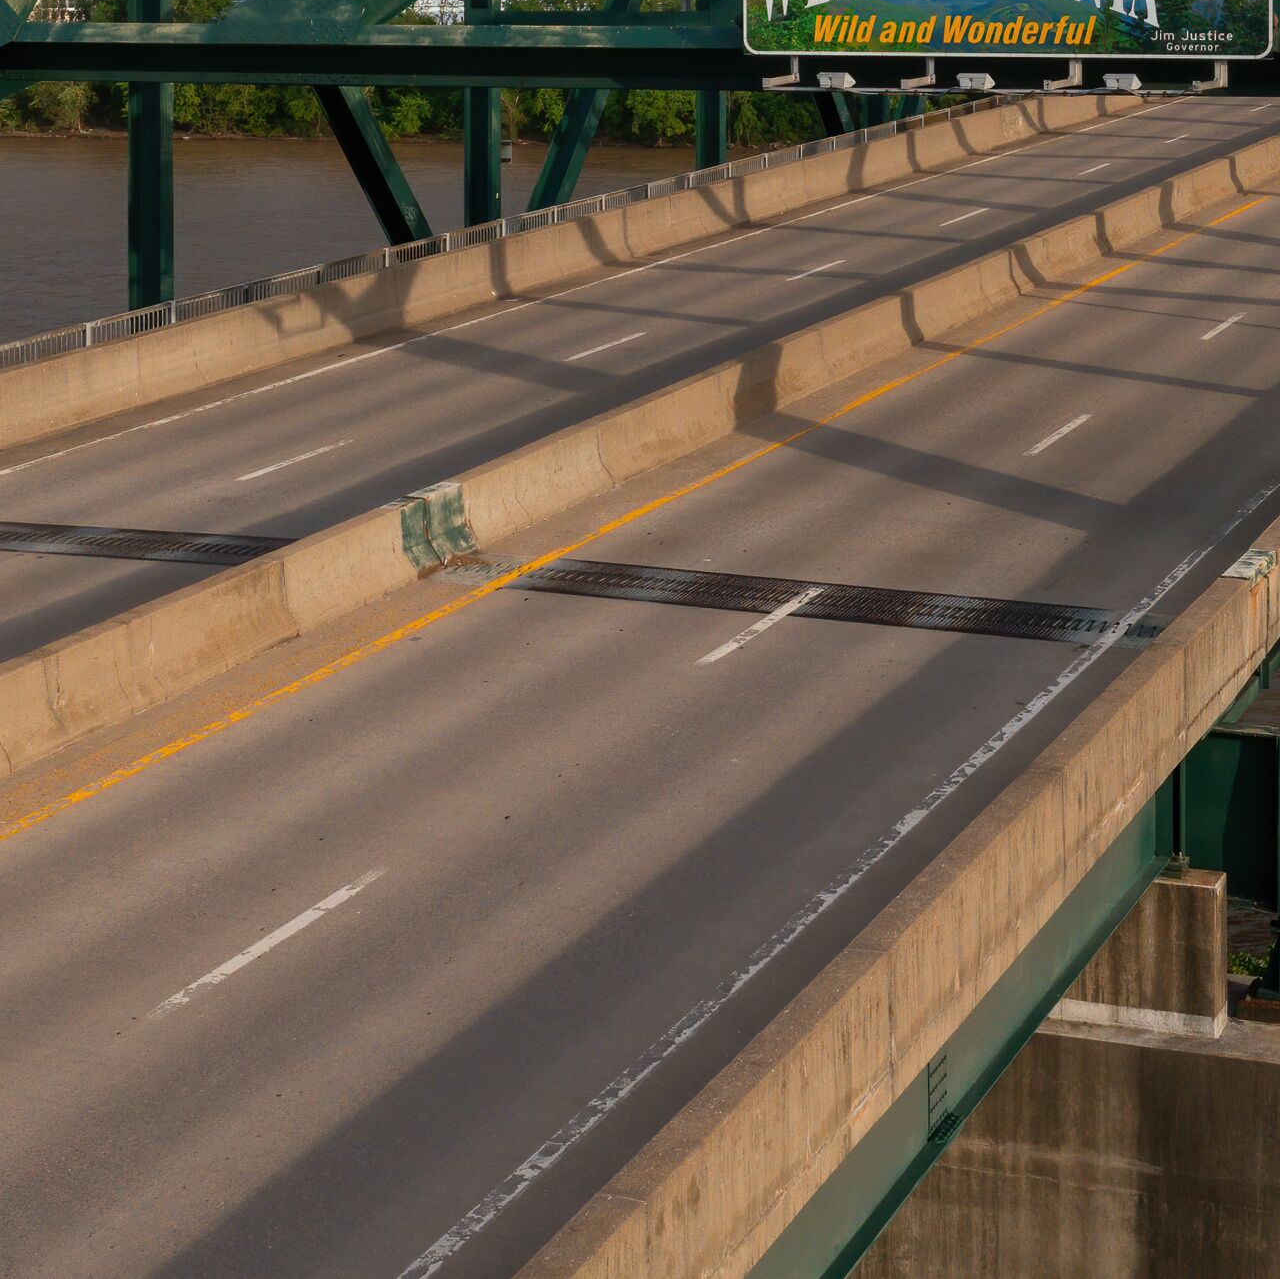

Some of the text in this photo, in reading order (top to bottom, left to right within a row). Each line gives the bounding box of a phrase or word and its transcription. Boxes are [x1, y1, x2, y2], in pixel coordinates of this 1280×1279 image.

[813, 14, 1097, 45] Wild and Wonderful
[1150, 29, 1233, 41] Jim Justice
[1166, 42, 1220, 52] Governor
